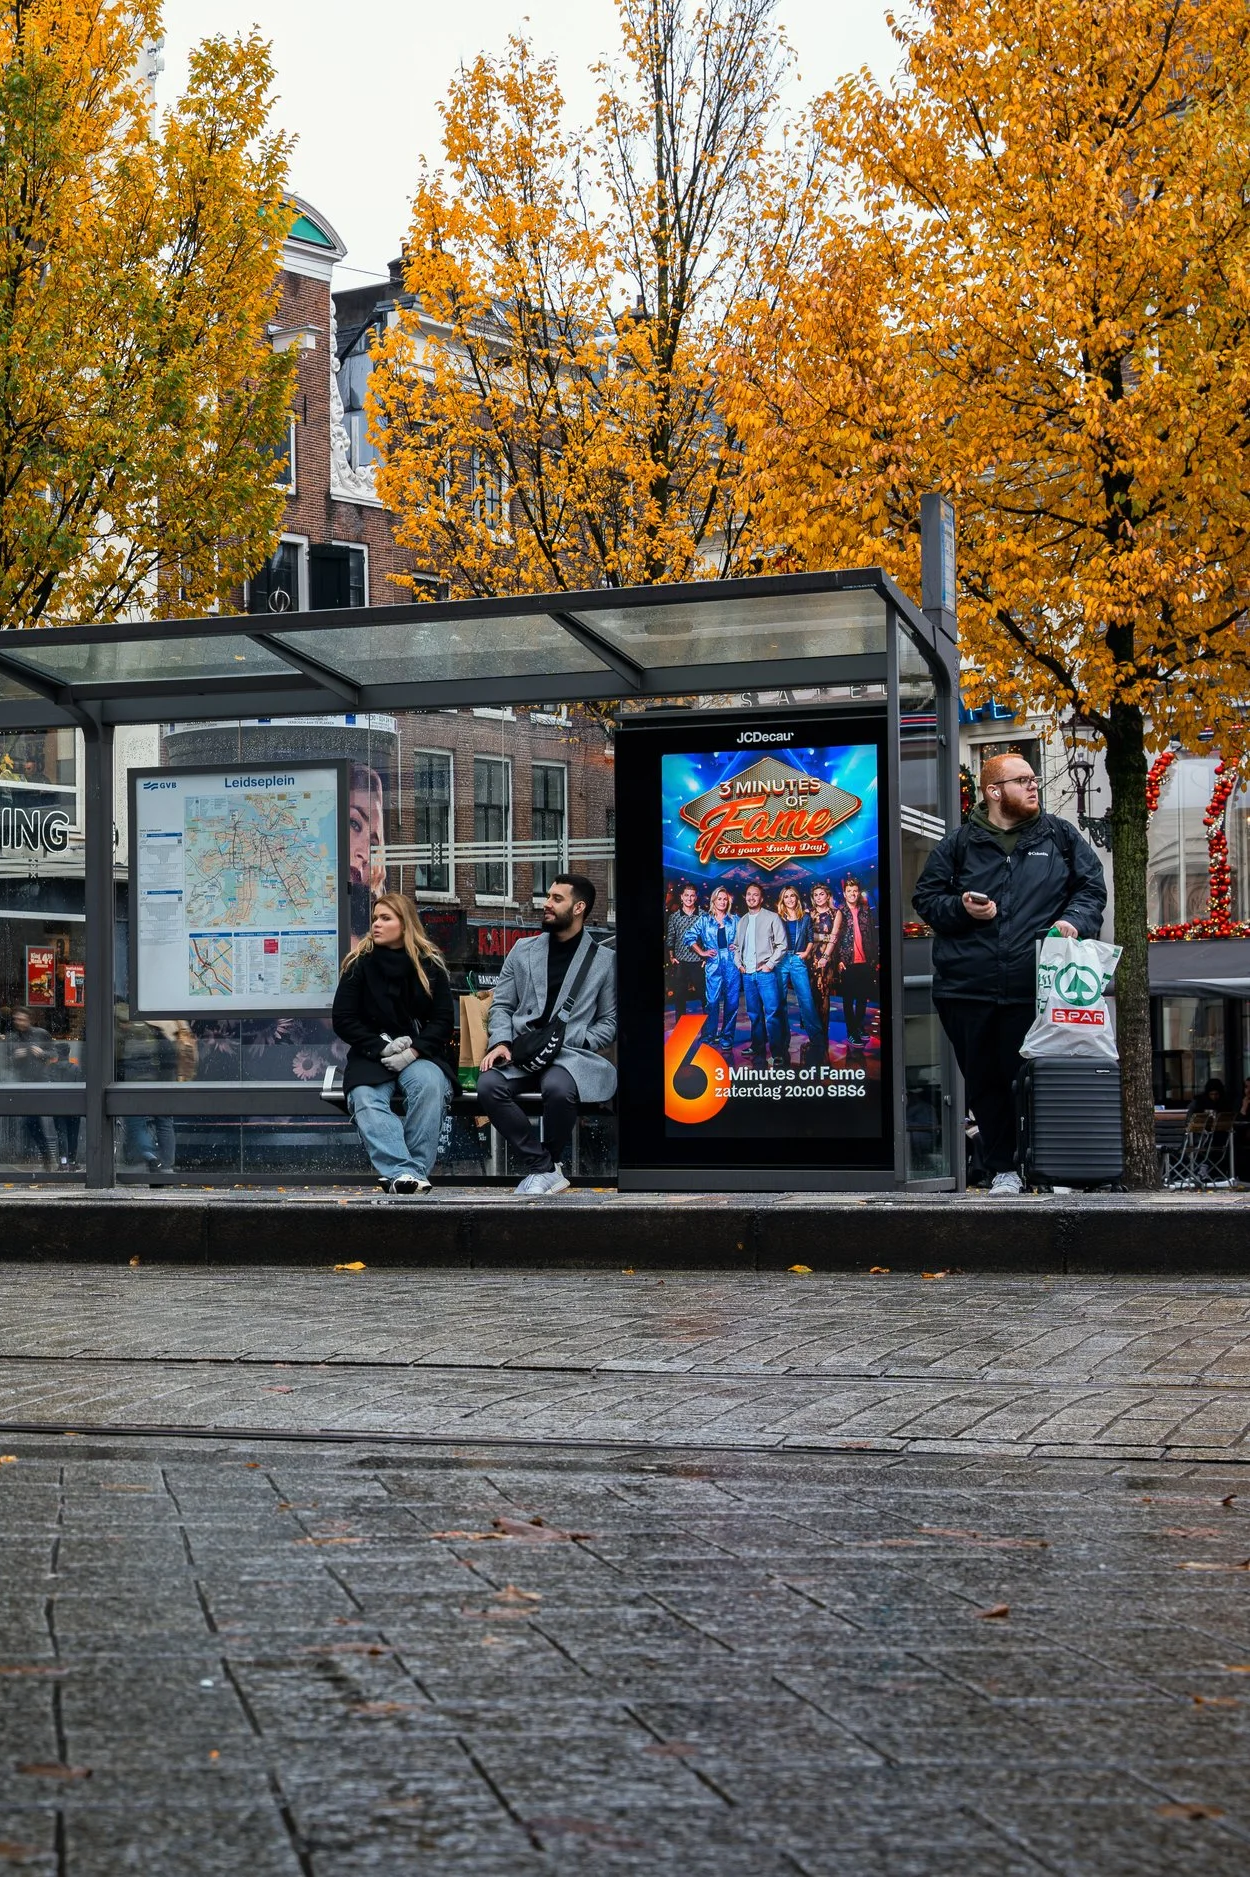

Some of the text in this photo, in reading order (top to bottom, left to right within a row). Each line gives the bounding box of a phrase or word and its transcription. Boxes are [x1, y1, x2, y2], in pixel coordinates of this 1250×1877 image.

[224, 775, 295, 789] Leidseplein
[718, 777, 822, 797] 3 MINUTES
[785, 795, 809, 807] OF
[695, 796, 836, 864] Fame
[717, 842, 827, 856] It's your Lucky Day!
[1054, 1010, 1104, 1023] SPAR
[665, 1015, 732, 1124] 6
[714, 1066, 866, 1081] 3 Minutes of Fame
[714, 1083, 866, 1100] zaterdag 20:00 SBS6
